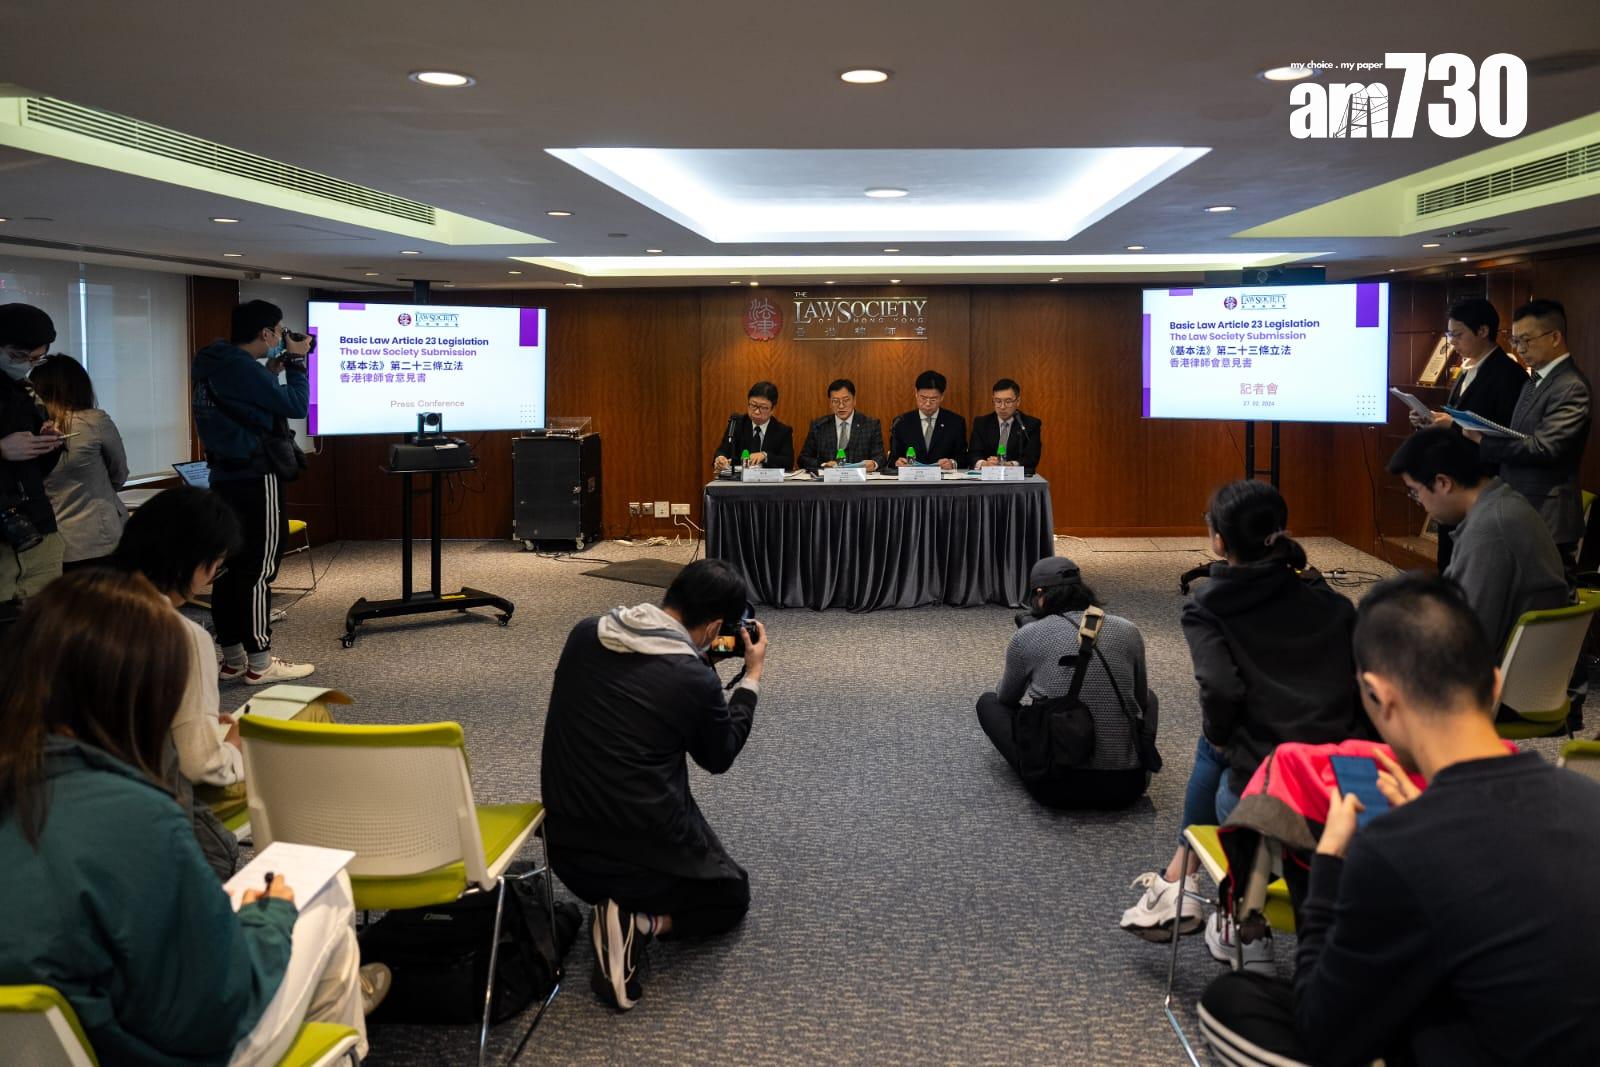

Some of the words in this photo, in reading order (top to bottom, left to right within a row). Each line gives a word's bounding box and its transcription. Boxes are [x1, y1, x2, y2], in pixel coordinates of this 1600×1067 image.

[1169, 321, 1195, 330] Basic
[1197, 321, 1216, 330] Law
[1217, 320, 1249, 329] Article
[1251, 320, 1263, 329] 23
[1264, 319, 1320, 331] Legislation
[339, 335, 368, 345] Basic
[369, 336, 390, 345] Law
[391, 336, 424, 345] Article
[425, 336, 437, 346] 23
[438, 336, 489, 347] Legislation
[1170, 332, 1187, 341] The
[1189, 332, 1208, 341] Law
[1209, 331, 1246, 343] Society
[1247, 331, 1306, 340] Submission
[340, 347, 359, 356] The
[360, 347, 381, 356] Law
[383, 347, 419, 358] Society
[421, 347, 477, 357] Submission
[1170, 357, 1253, 368] 香港律師會意見書
[339, 372, 427, 384] 香港律師會意見書
[1240, 382, 1279, 396] 記者會
[390, 399, 415, 408] Press
[417, 399, 465, 408] Conference
